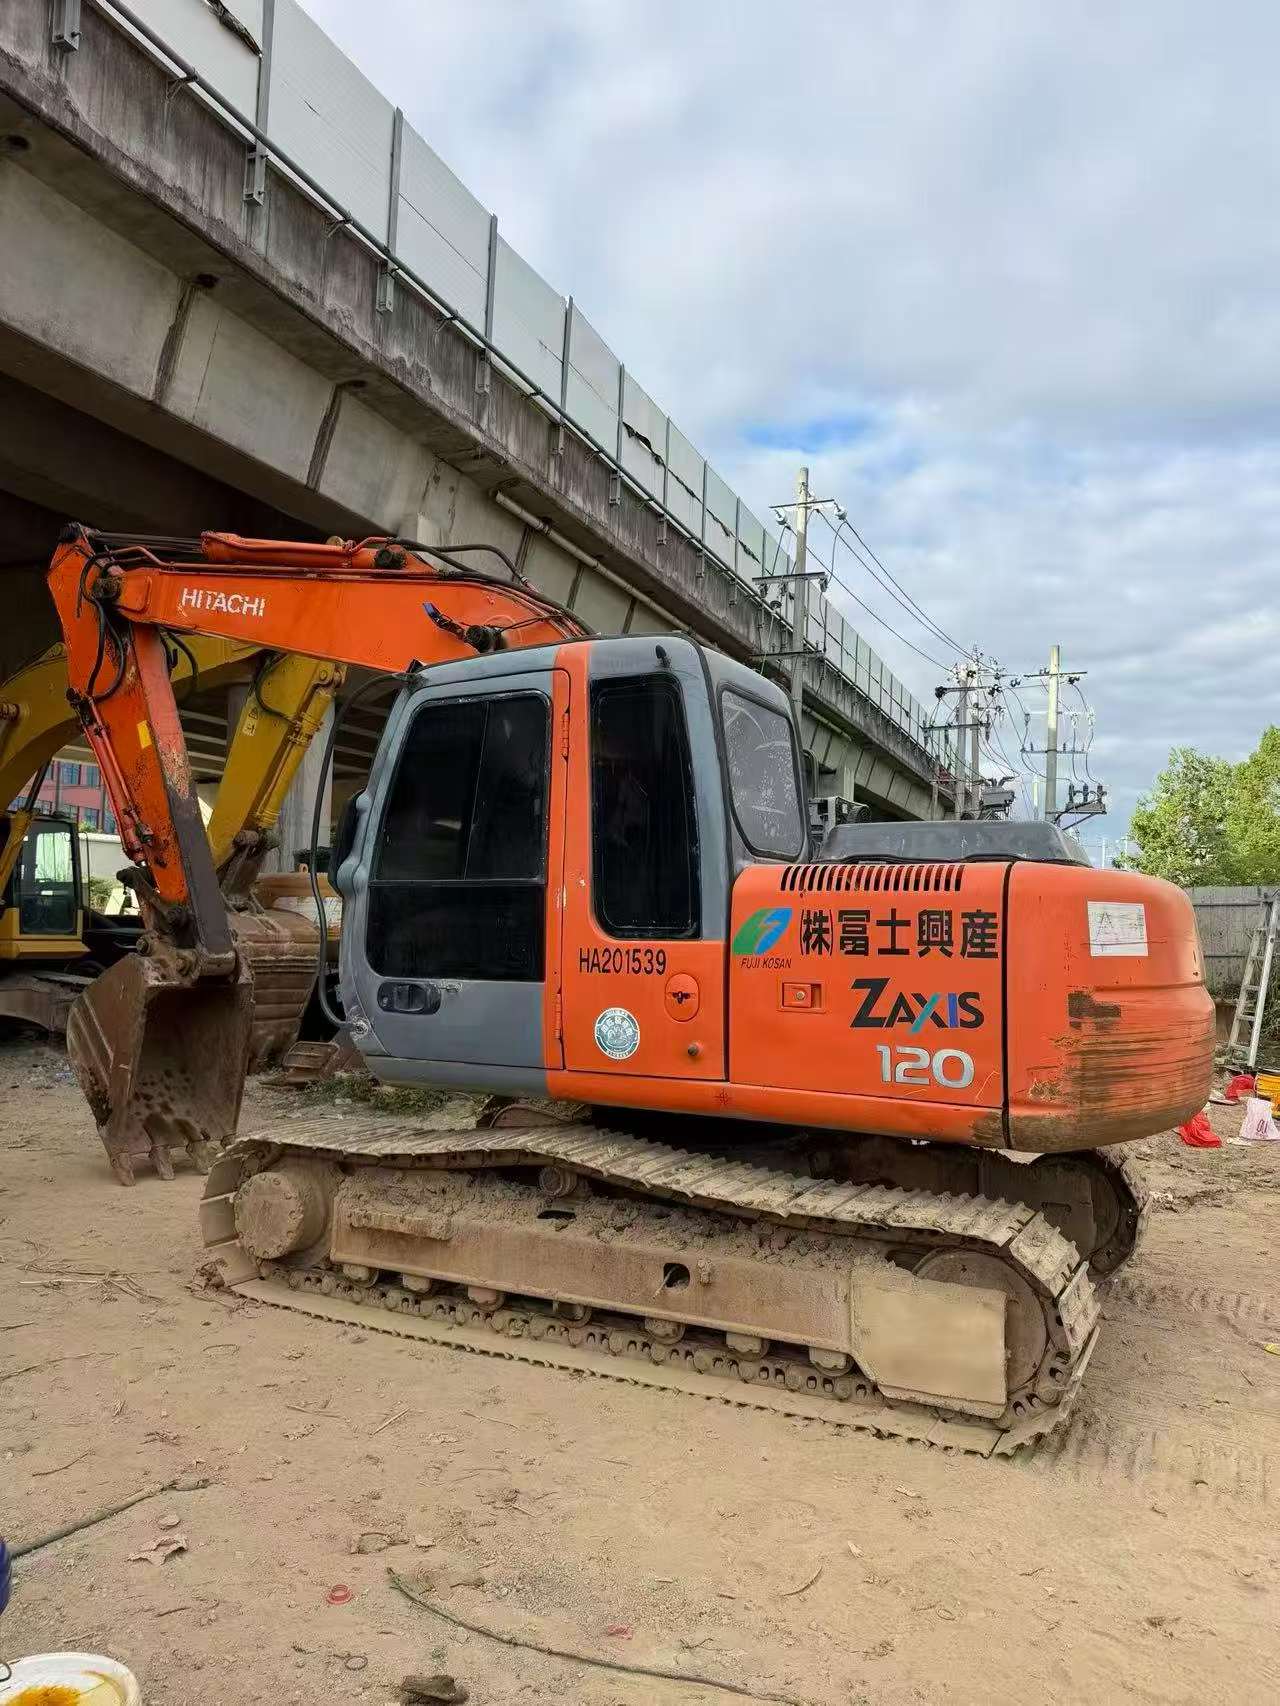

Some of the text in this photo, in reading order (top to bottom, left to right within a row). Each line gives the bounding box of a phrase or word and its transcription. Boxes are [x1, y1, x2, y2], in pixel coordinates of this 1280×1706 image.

[181, 587, 266, 617] HITACHI
[578, 947, 667, 976] HA201539
[740, 957, 792, 969] FUJI KOSAN
[850, 977, 985, 1034] ZAXIS
[876, 1044, 975, 1089] 120
